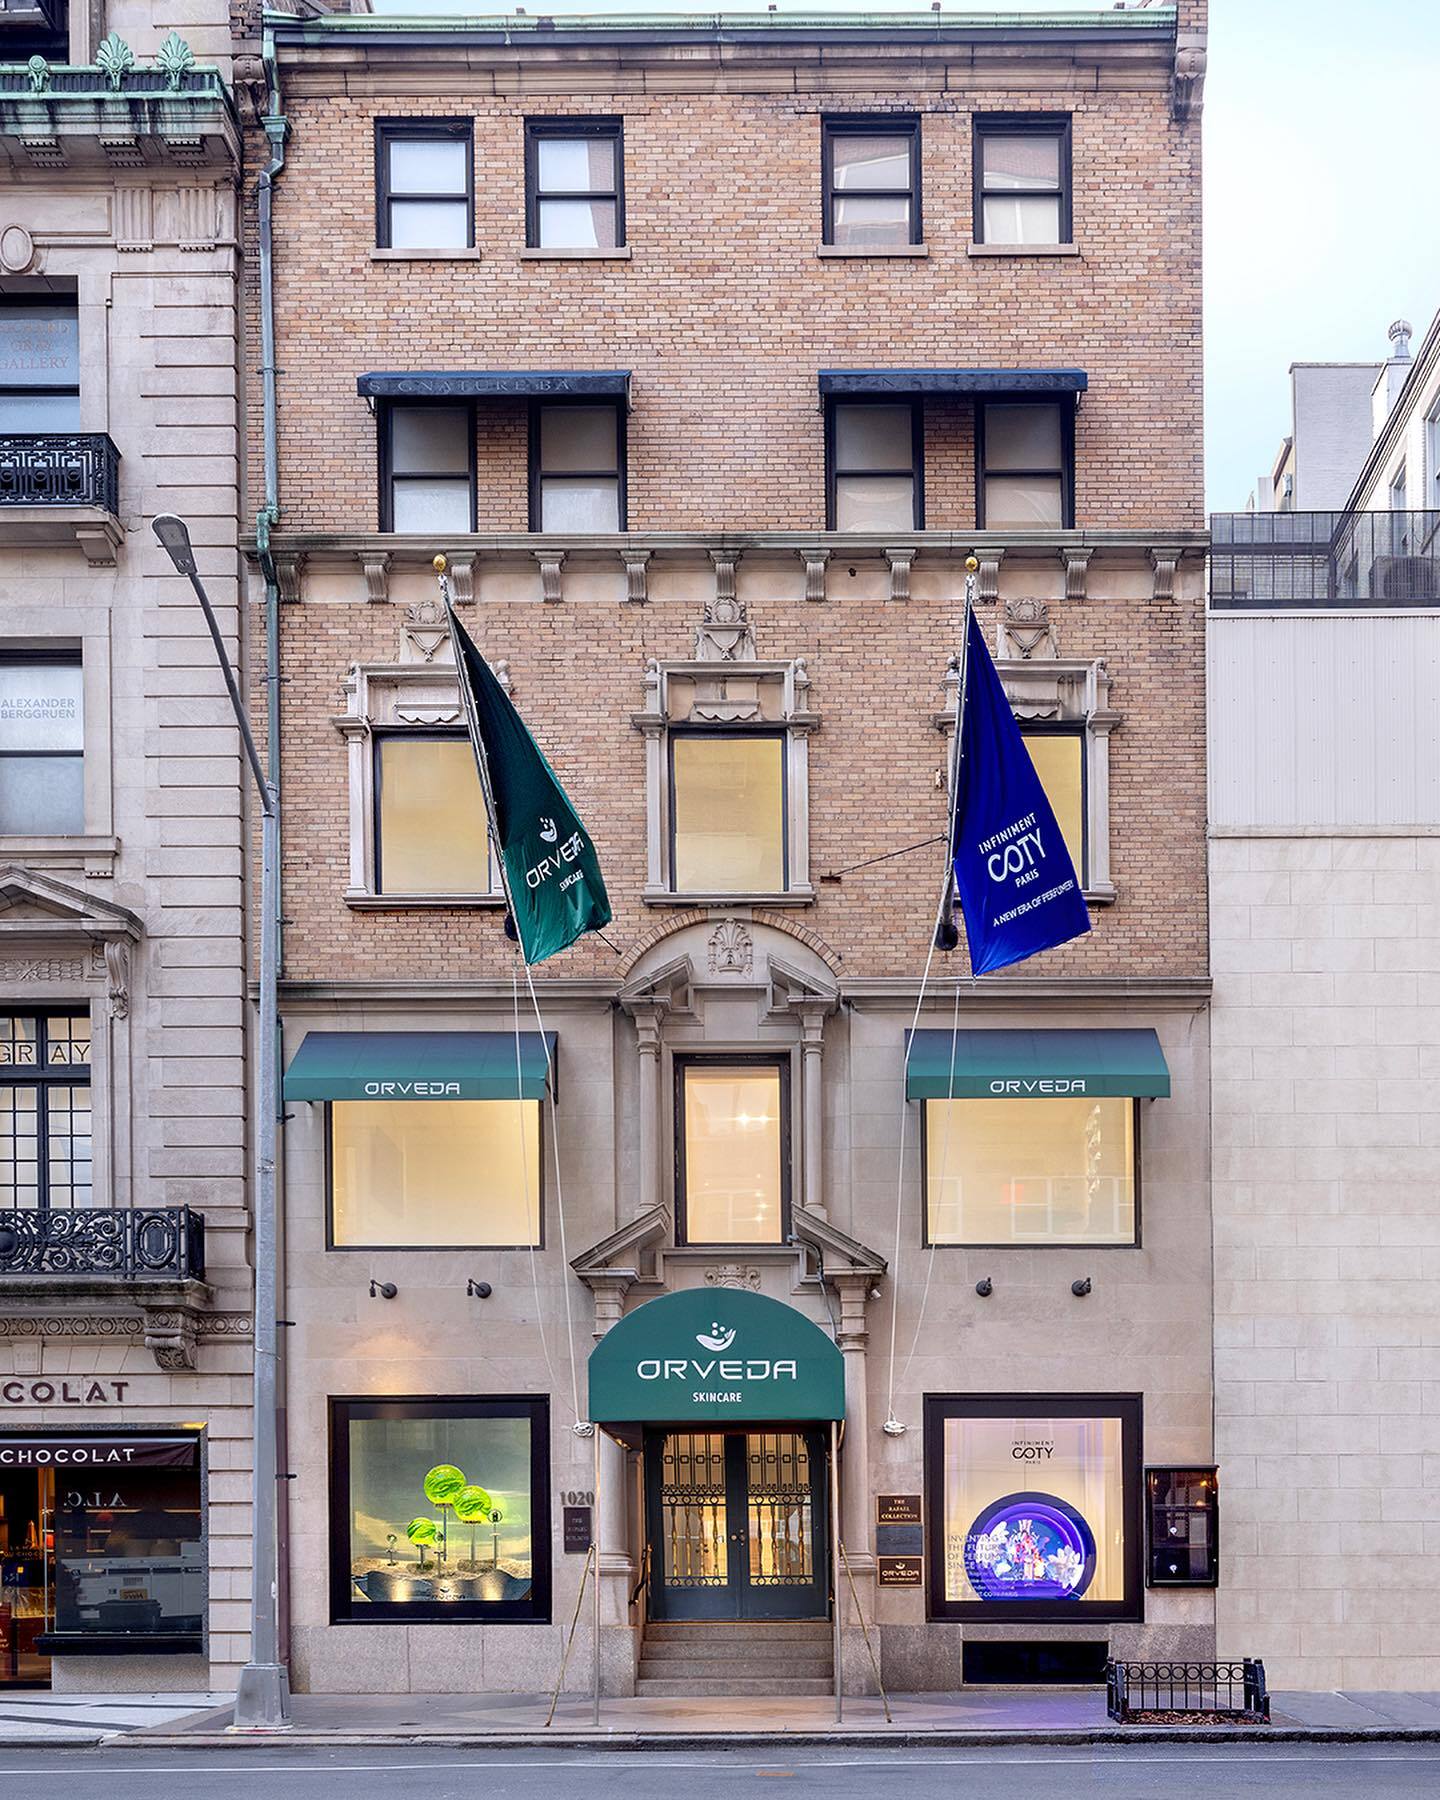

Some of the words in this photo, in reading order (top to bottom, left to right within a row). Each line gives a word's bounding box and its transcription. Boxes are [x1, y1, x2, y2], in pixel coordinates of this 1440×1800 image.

[0, 356, 68, 368] GALLERY
[369, 378, 526, 393] SGNATURE
[1, 699, 75, 708] ALEXANDER
[1, 709, 75, 719] BERGGRUEN
[978, 812, 1036, 854] INFINIMENT
[987, 827, 1046, 882] COTY
[1015, 868, 1039, 888] PARIS
[993, 918, 1000, 927] A
[999, 907, 1017, 924] NEW
[1017, 902, 1033, 915] ERA
[1031, 896, 1042, 908] OF
[0, 1044, 90, 1063] GRAY
[364, 1082, 460, 1095] ORVEDA
[990, 1080, 1086, 1093] ORVEDA
[636, 1360, 797, 1380] ORVEDA
[3, 1382, 129, 1403] COLAT
[692, 1392, 742, 1403] SKINCARE
[0, 1448, 135, 1463] CHOCOLAT
[1012, 1447, 1054, 1459] COTY
[560, 1491, 595, 1506] 1020
